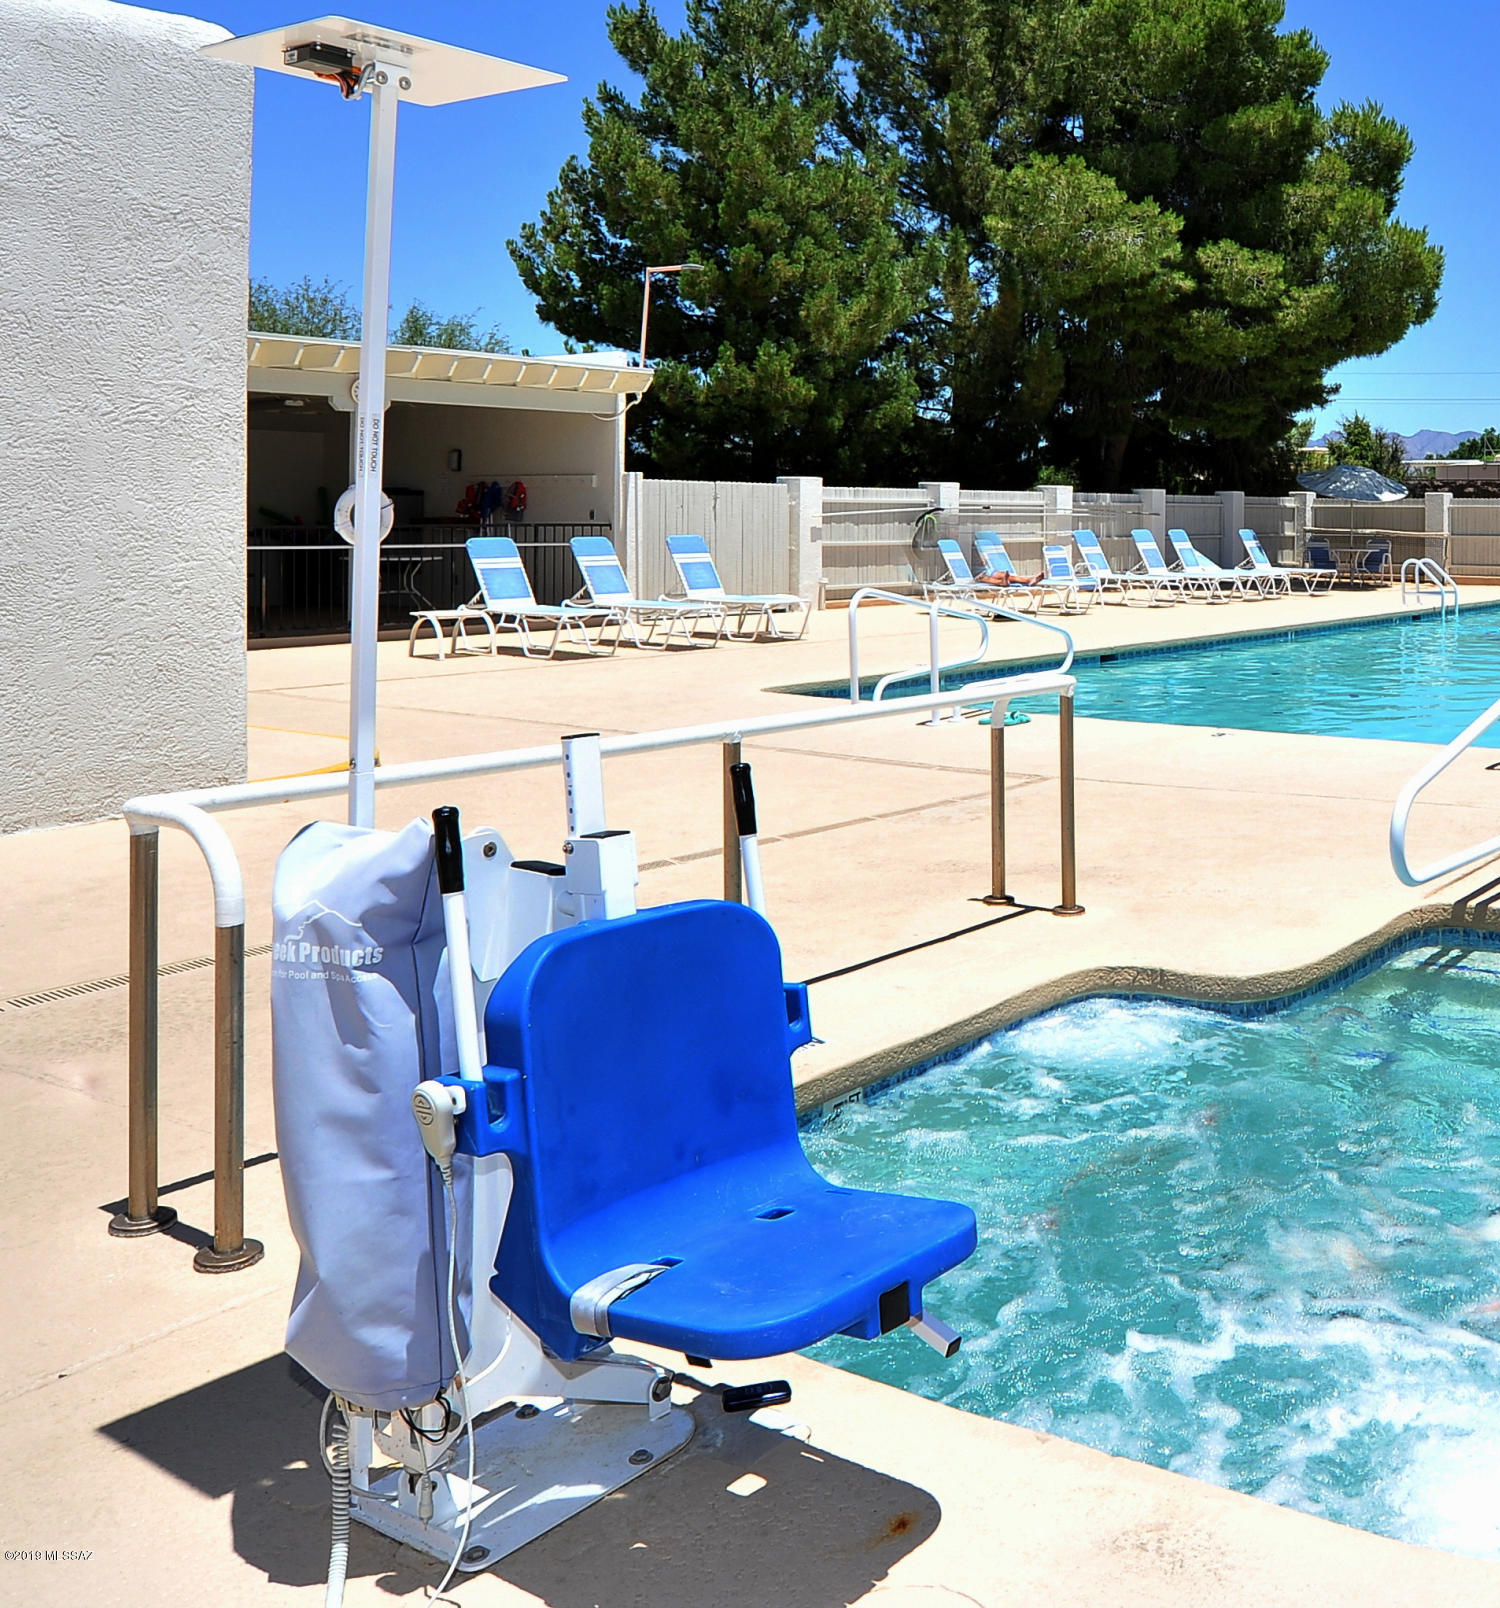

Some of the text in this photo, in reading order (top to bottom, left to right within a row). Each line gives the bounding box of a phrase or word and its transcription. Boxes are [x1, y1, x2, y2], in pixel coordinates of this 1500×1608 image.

[370, 418, 380, 472] DO NOT TOUCH
[299, 942, 384, 968] Products
[288, 969, 309, 980] Pool
[311, 970, 329, 980] and
